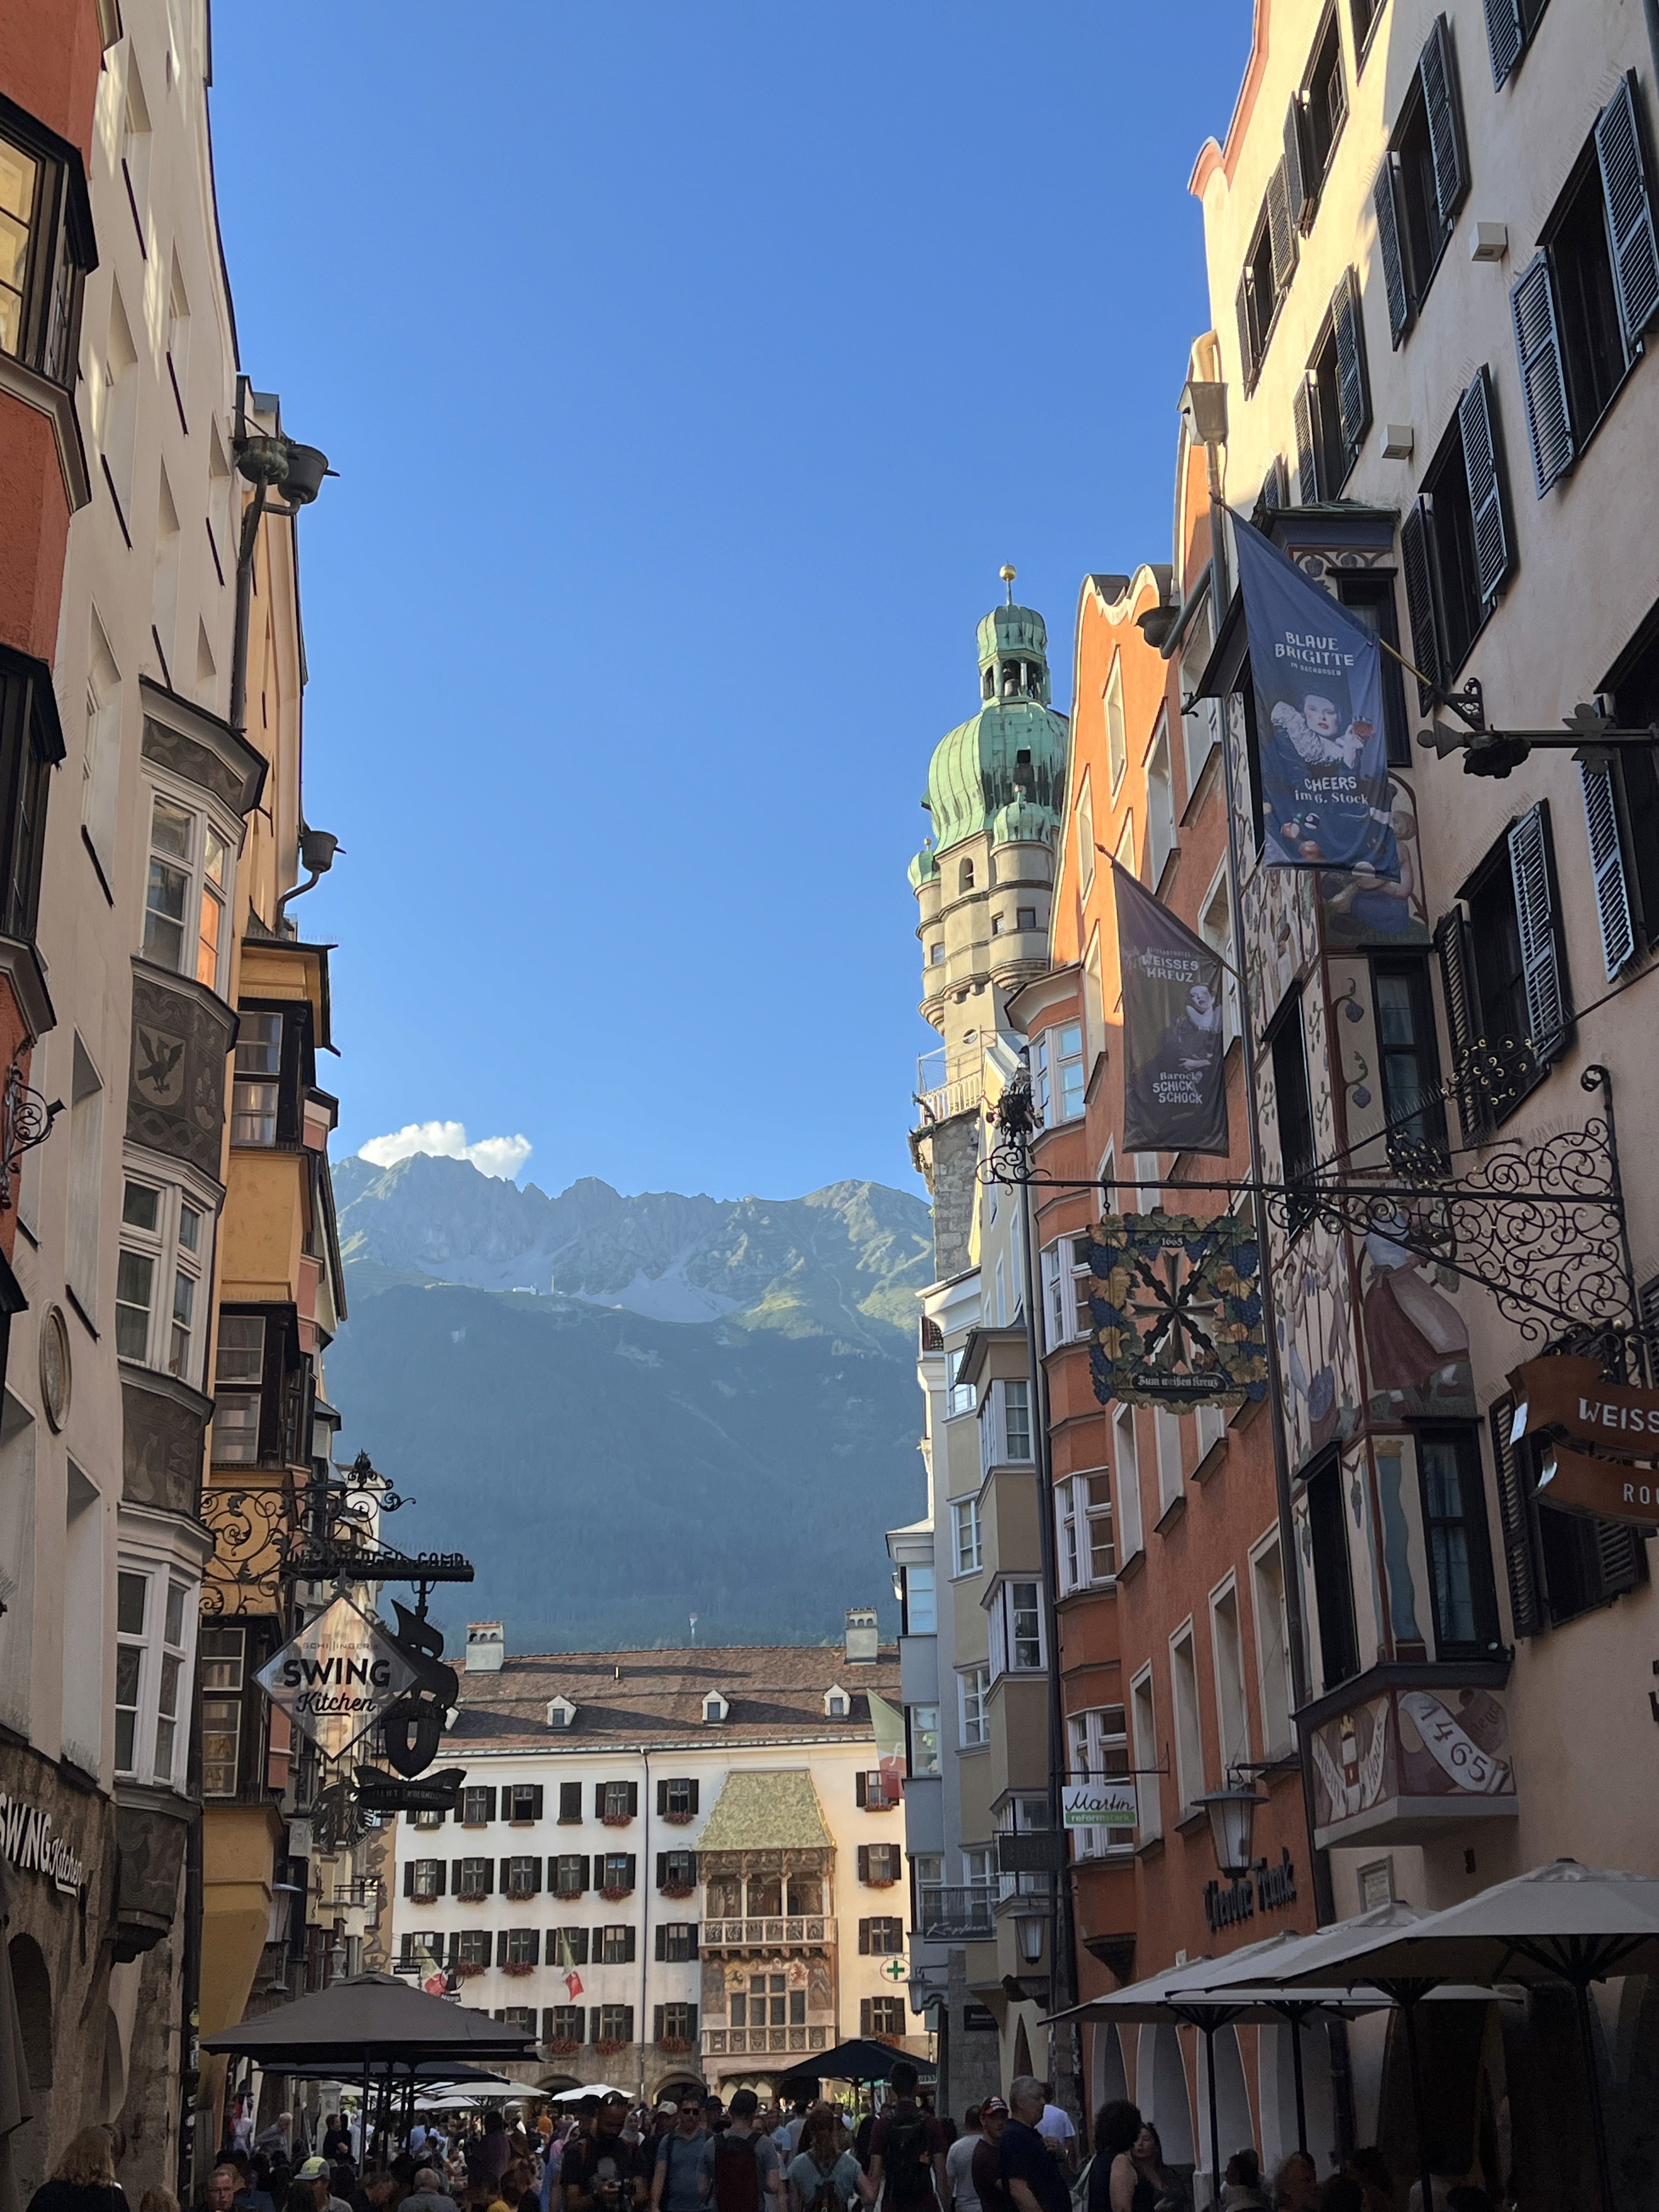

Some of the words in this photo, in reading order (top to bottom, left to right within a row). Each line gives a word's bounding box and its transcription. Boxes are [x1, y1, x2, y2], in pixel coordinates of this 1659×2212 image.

[1285, 631, 1339, 651] BLAUE
[1274, 643, 1355, 667] BRIGITTE
[1304, 776, 1357, 792] CHEERS
[1295, 789, 1312, 801] im
[1331, 792, 1369, 805] Stock
[1141, 955, 1199, 971] WEISSES
[1147, 967, 1194, 983] KREUZ
[1160, 1071, 1198, 1080] Barock
[1152, 1081, 1193, 1093] SCHICK
[1158, 1092, 1203, 1104] SCHOCK
[283, 1657, 390, 1688] SWING
[296, 1692, 376, 1717] Kitchen
[1065, 1791, 1135, 1811] Martin
